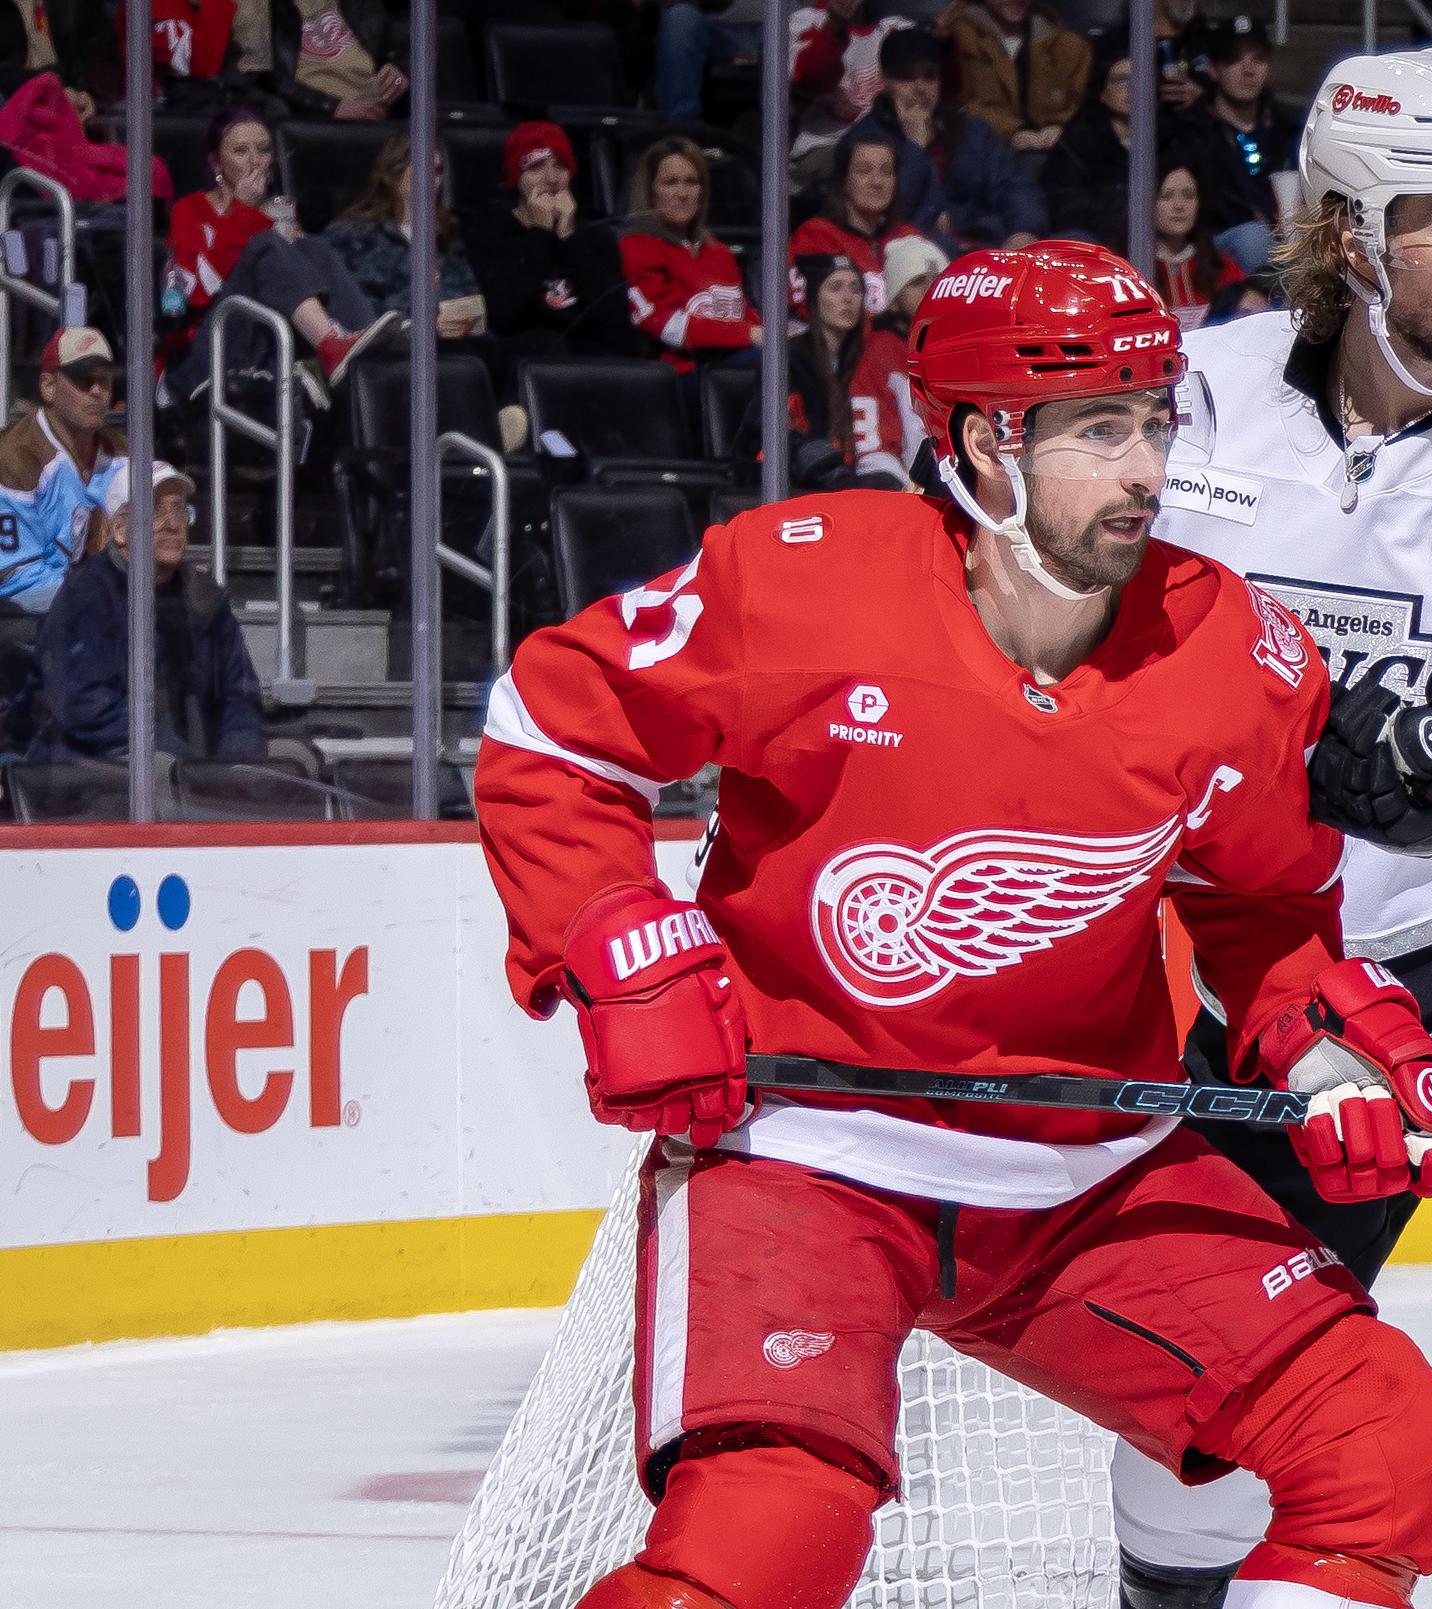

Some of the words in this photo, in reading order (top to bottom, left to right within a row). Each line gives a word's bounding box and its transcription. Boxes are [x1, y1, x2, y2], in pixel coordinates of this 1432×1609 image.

[1351, 91, 1402, 116] twilio
[931, 267, 1013, 304] meijer
[1093, 273, 1147, 303] 71
[1112, 330, 1171, 352] CCM
[1165, 478, 1207, 497] IRON
[1212, 486, 1258, 508] BOW
[1304, 609, 1394, 637] Angeles
[829, 723, 903, 748] PRIORITY
[1186, 764, 1245, 830] C
